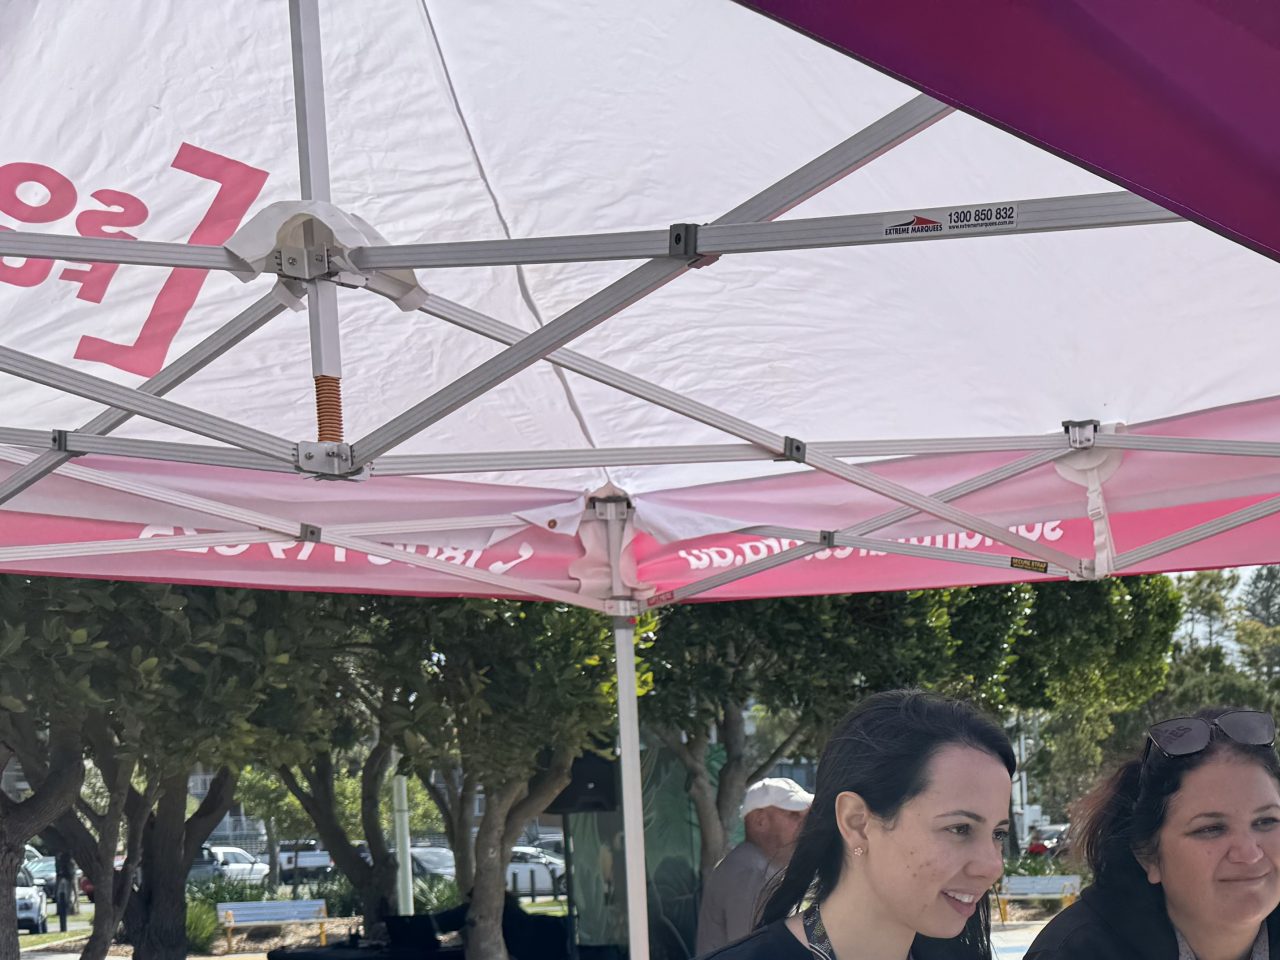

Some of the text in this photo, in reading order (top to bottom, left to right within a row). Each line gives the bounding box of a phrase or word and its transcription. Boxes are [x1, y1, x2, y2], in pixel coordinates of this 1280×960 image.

[948, 206, 1014, 224] 1300 850 832
[885, 224, 943, 236] EXTREME MARQUEES
